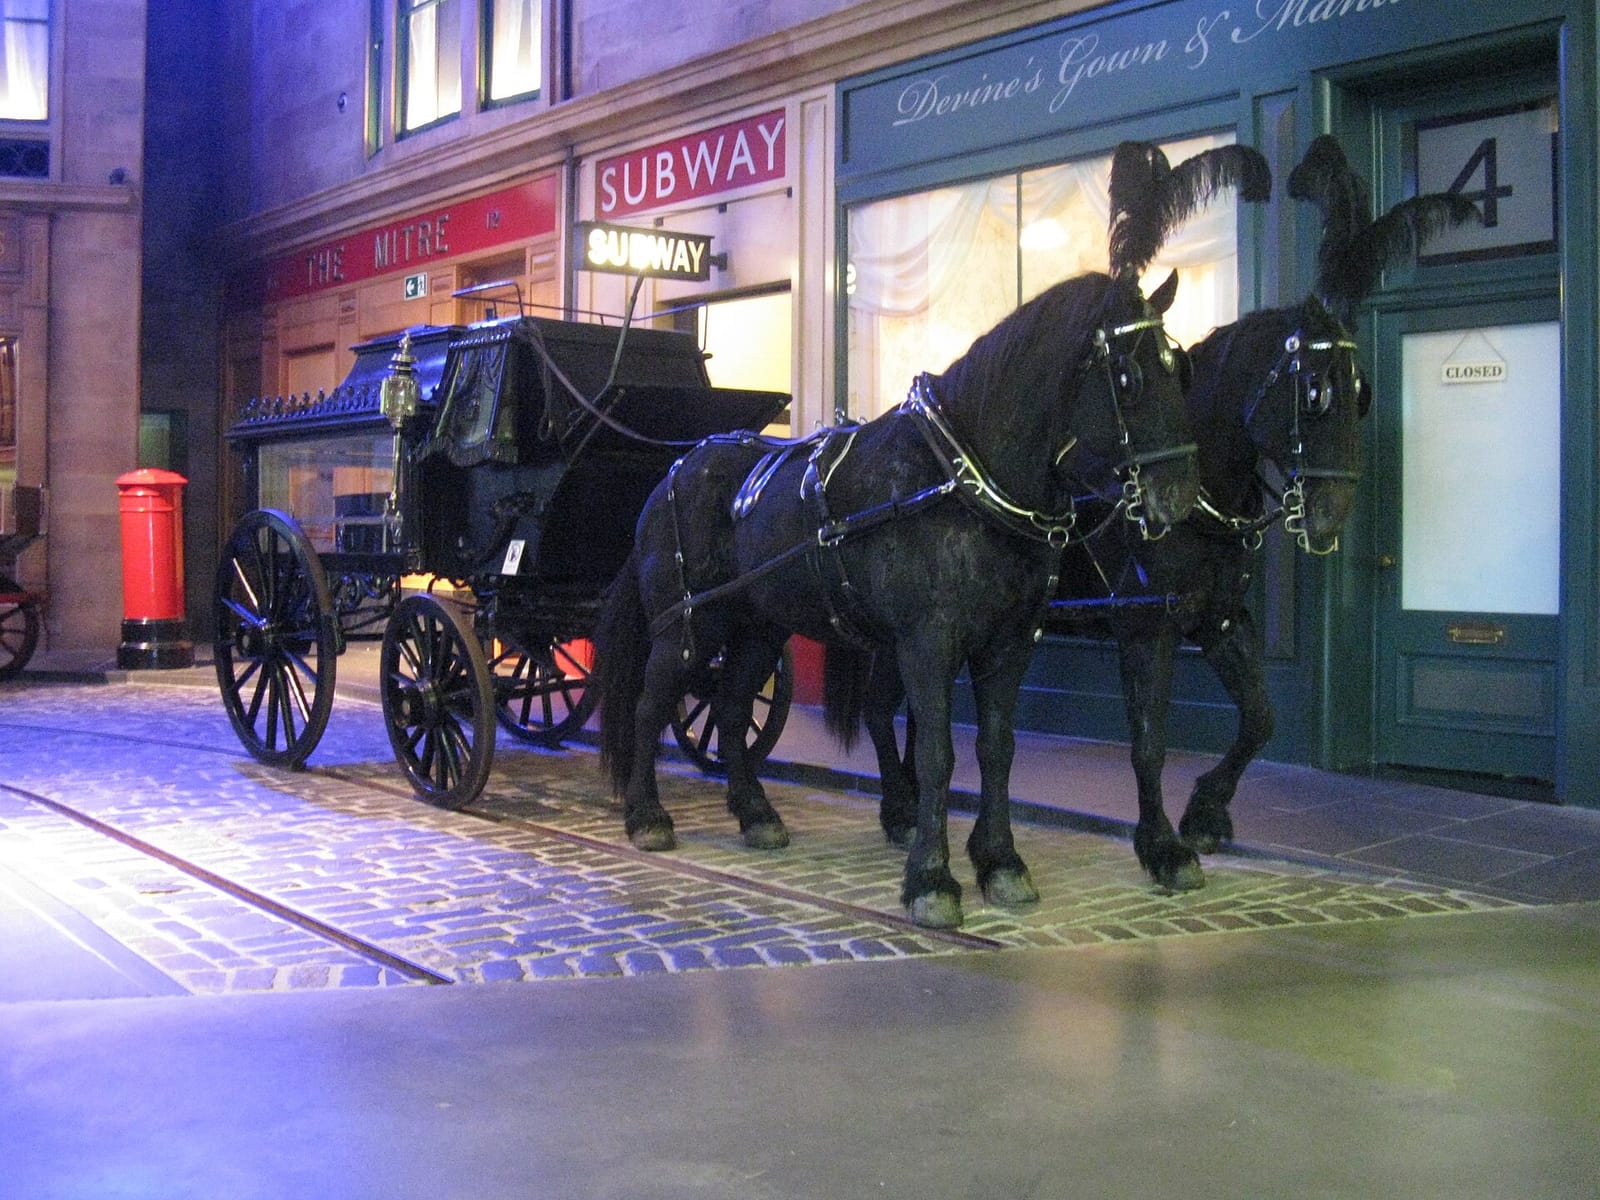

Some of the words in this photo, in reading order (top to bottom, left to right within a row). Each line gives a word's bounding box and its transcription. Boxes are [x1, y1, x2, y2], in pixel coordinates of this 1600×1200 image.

[892, 56, 1046, 127] Devine's
[1049, 34, 1171, 113] Gown
[1185, 10, 1230, 70] &
[601, 118, 784, 212] SUBWAY
[1447, 138, 1513, 228] 4
[306, 245, 344, 286] THE
[374, 214, 449, 269] MITRE
[588, 229, 705, 273] SUBWAY
[1446, 366, 1503, 378] CLOSED
